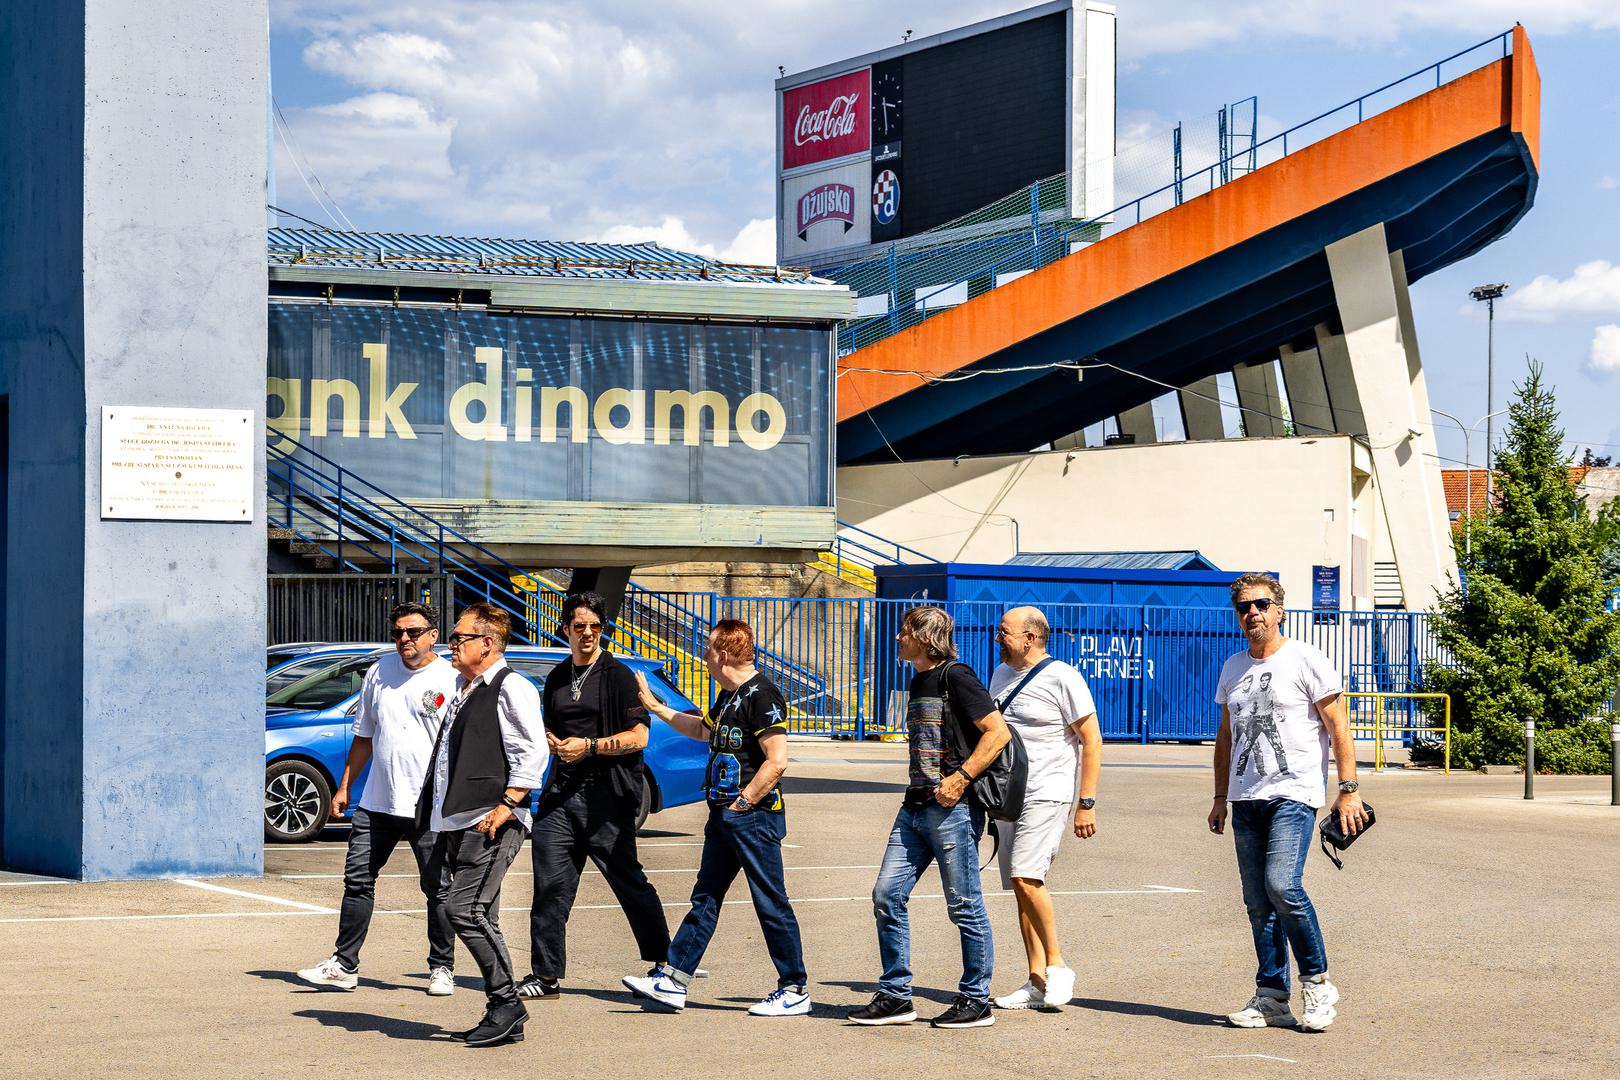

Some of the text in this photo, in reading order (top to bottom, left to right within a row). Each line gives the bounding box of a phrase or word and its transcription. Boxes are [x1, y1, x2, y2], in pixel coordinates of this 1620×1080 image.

[802, 186, 850, 225] Ožujsko
[267, 343, 787, 460] gnk dinamo
[1081, 635, 1142, 657] PLAVI
